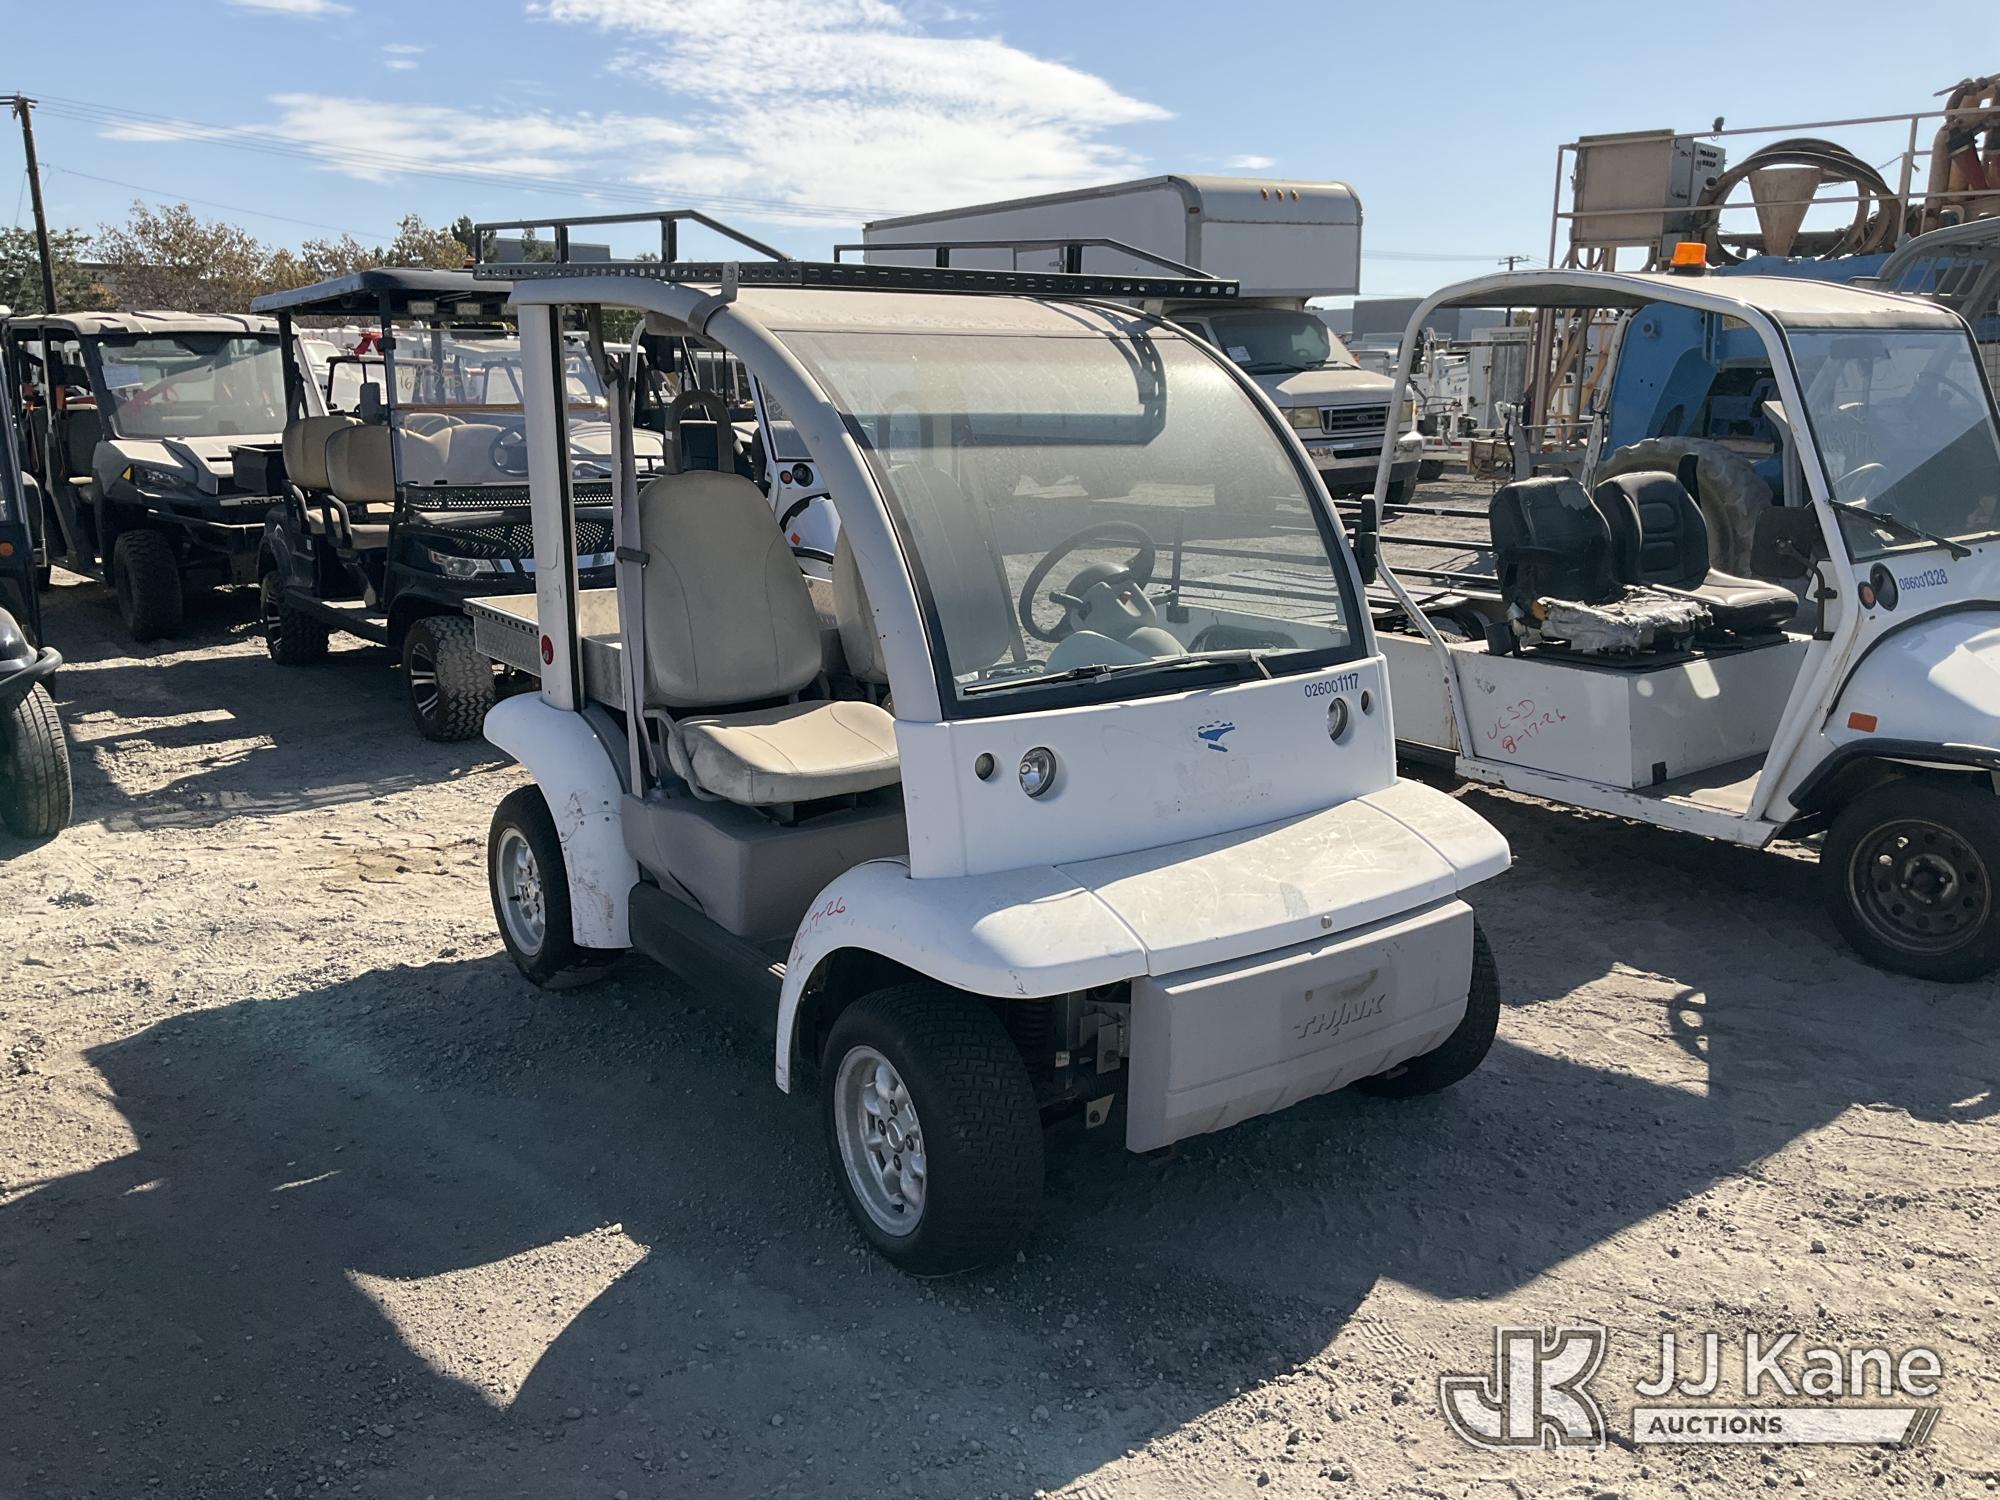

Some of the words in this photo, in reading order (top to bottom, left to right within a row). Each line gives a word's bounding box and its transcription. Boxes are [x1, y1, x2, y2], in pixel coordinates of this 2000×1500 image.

[1898, 568, 1948, 591] 086031328
[1304, 672, 1359, 698] 026001117
[1487, 699, 1536, 740] UCSD
